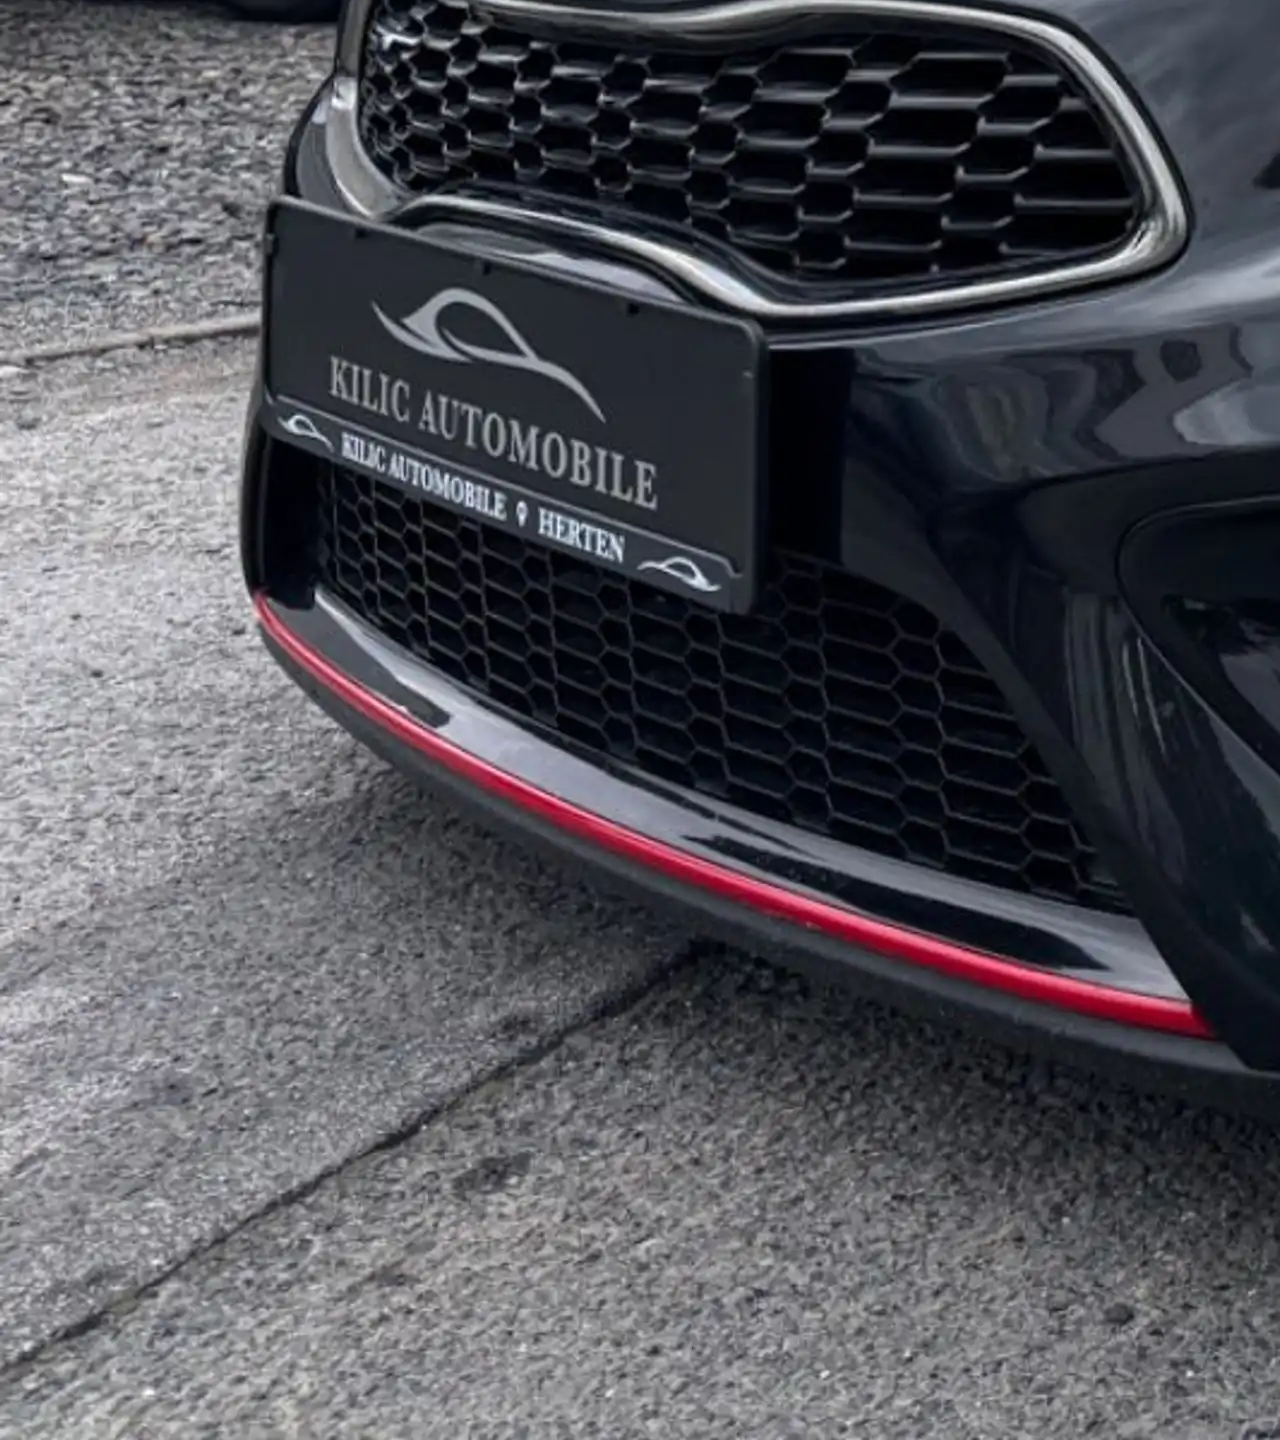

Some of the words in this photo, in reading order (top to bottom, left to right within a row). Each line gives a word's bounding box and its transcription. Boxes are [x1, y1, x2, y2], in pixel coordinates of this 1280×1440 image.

[329, 356, 410, 423] KILIC
[418, 390, 658, 511] AUTOMOBILE
[341, 432, 386, 474] KILIC
[388, 455, 507, 522] AUTOMOBILE
[538, 507, 626, 563] HERTEN
